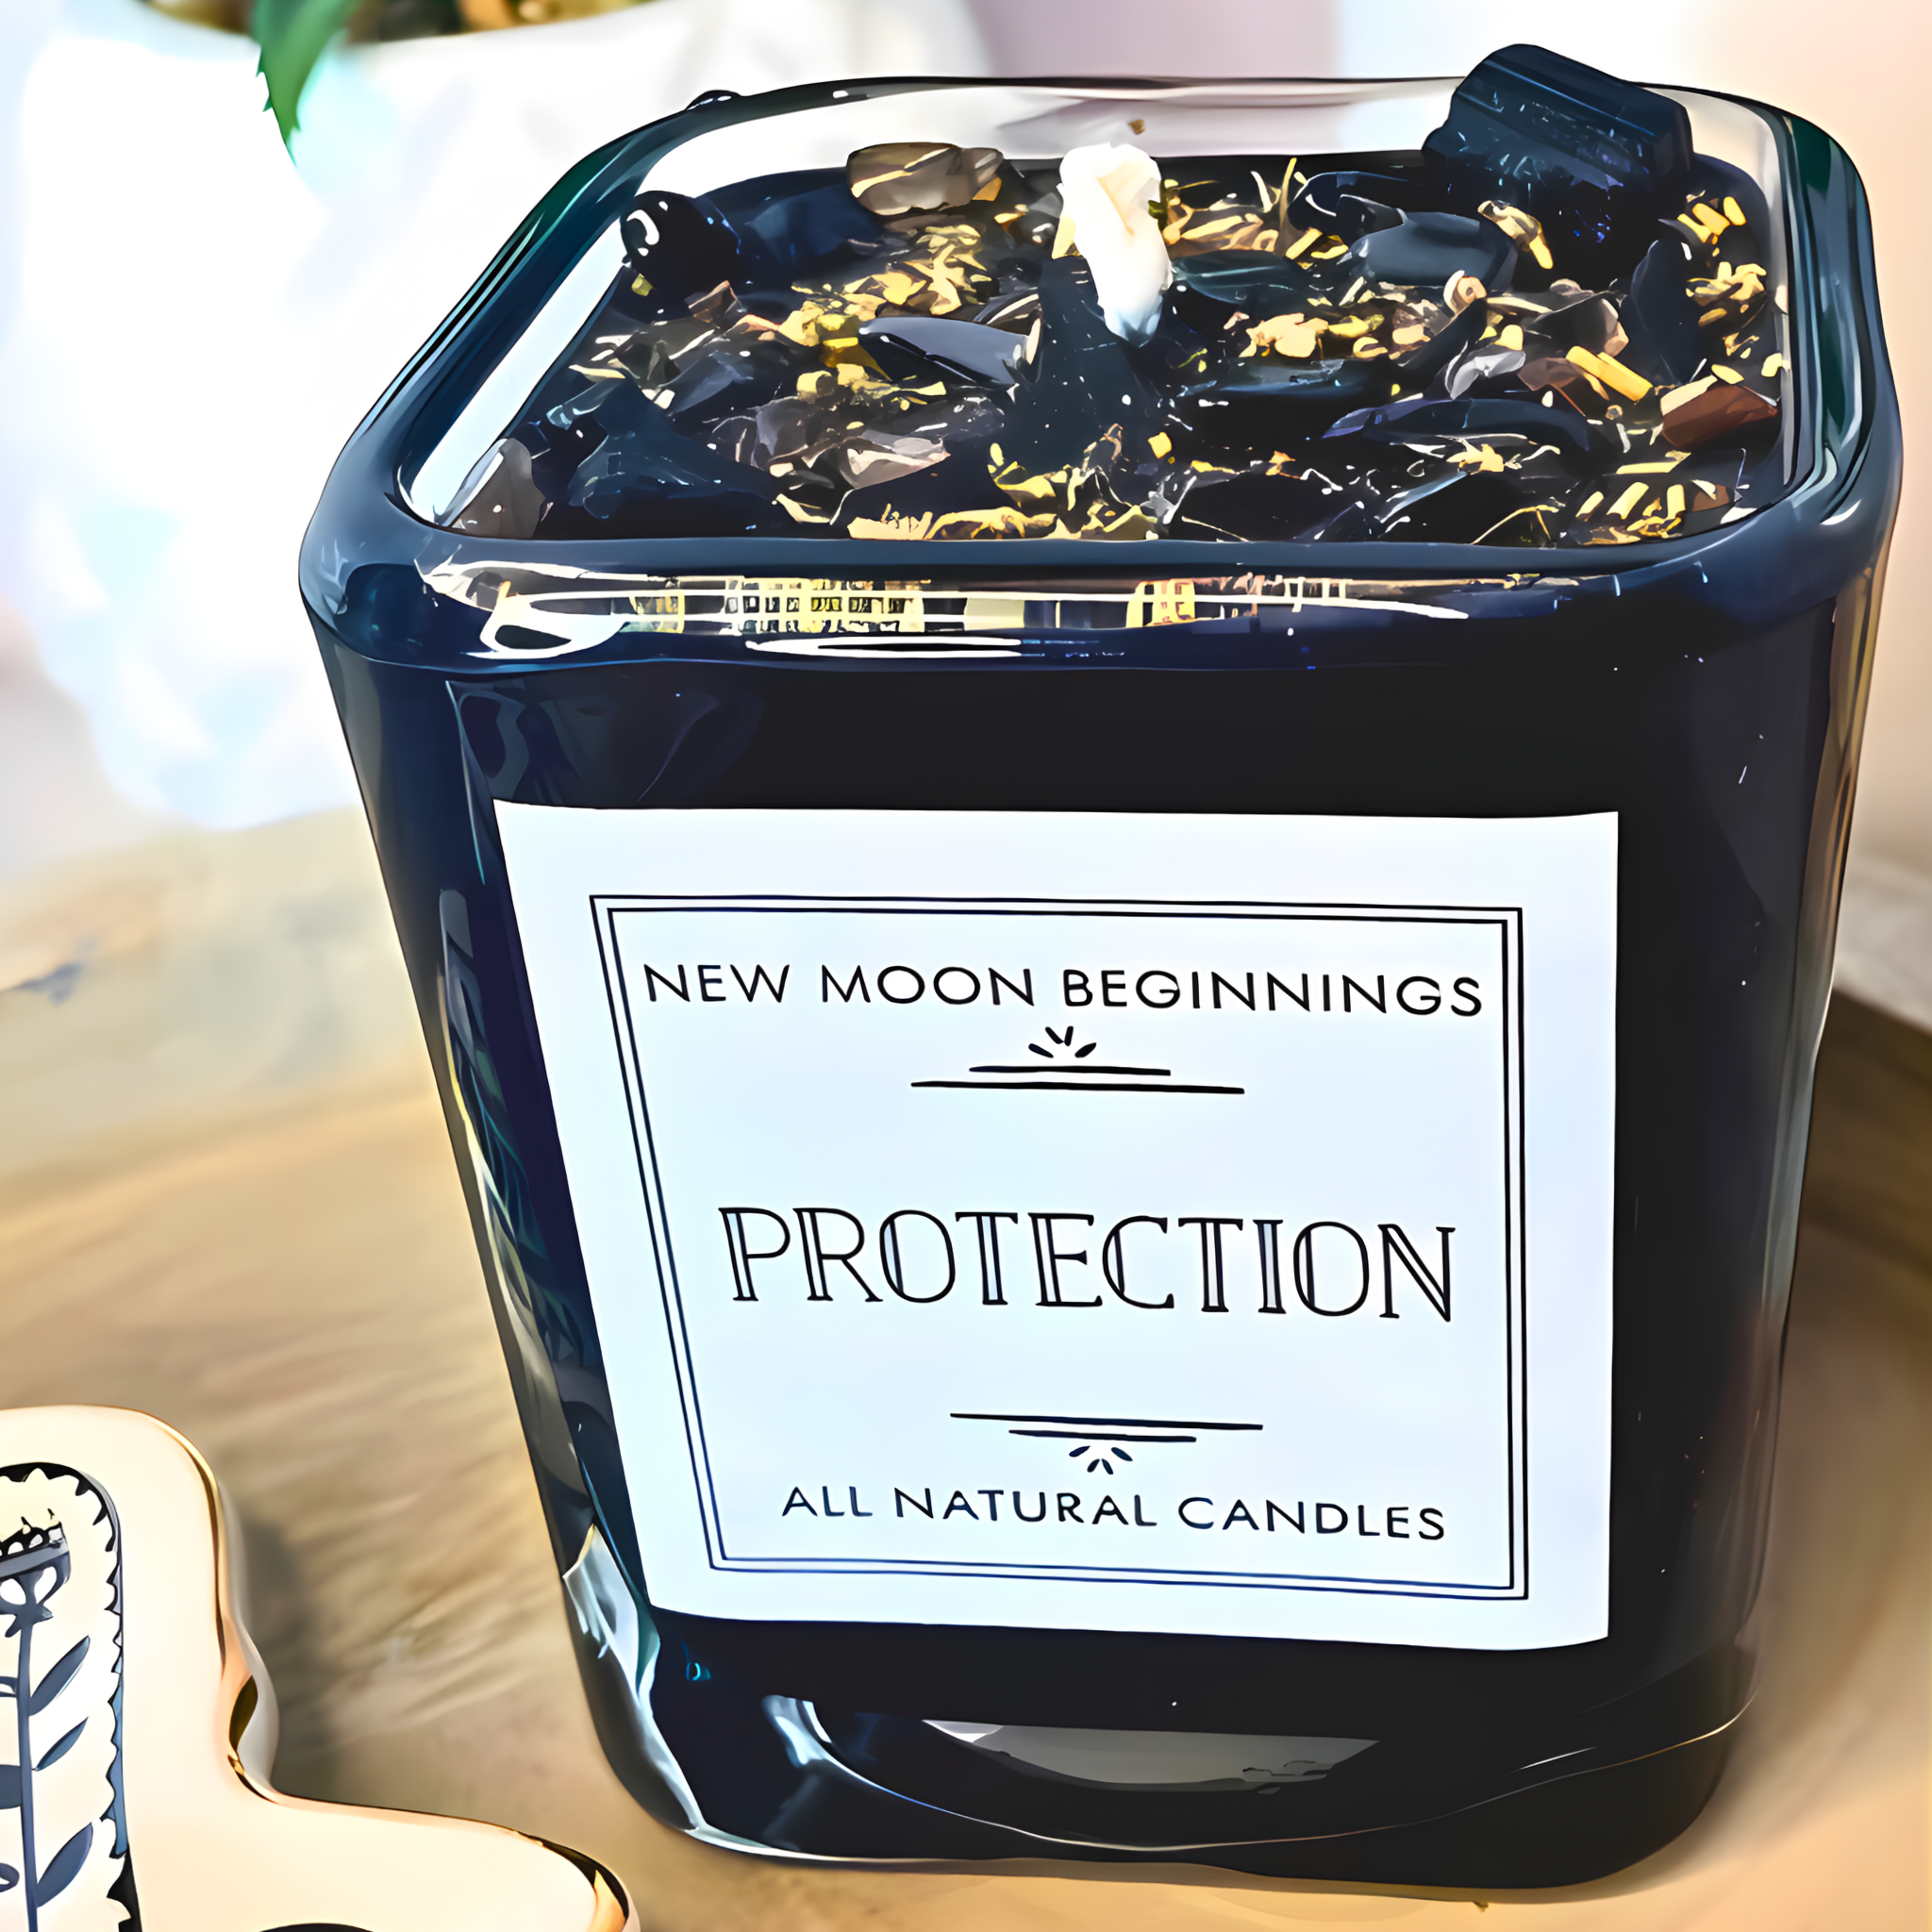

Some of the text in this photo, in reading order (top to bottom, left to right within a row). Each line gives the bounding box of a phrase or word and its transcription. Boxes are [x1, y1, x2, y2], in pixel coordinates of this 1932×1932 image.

[643, 963, 1482, 1017] NEW MOON BEGINNINGS
[717, 1207, 1457, 1323] PROTECTION
[781, 1486, 1445, 1541] ALL NATURAL CANDLES
